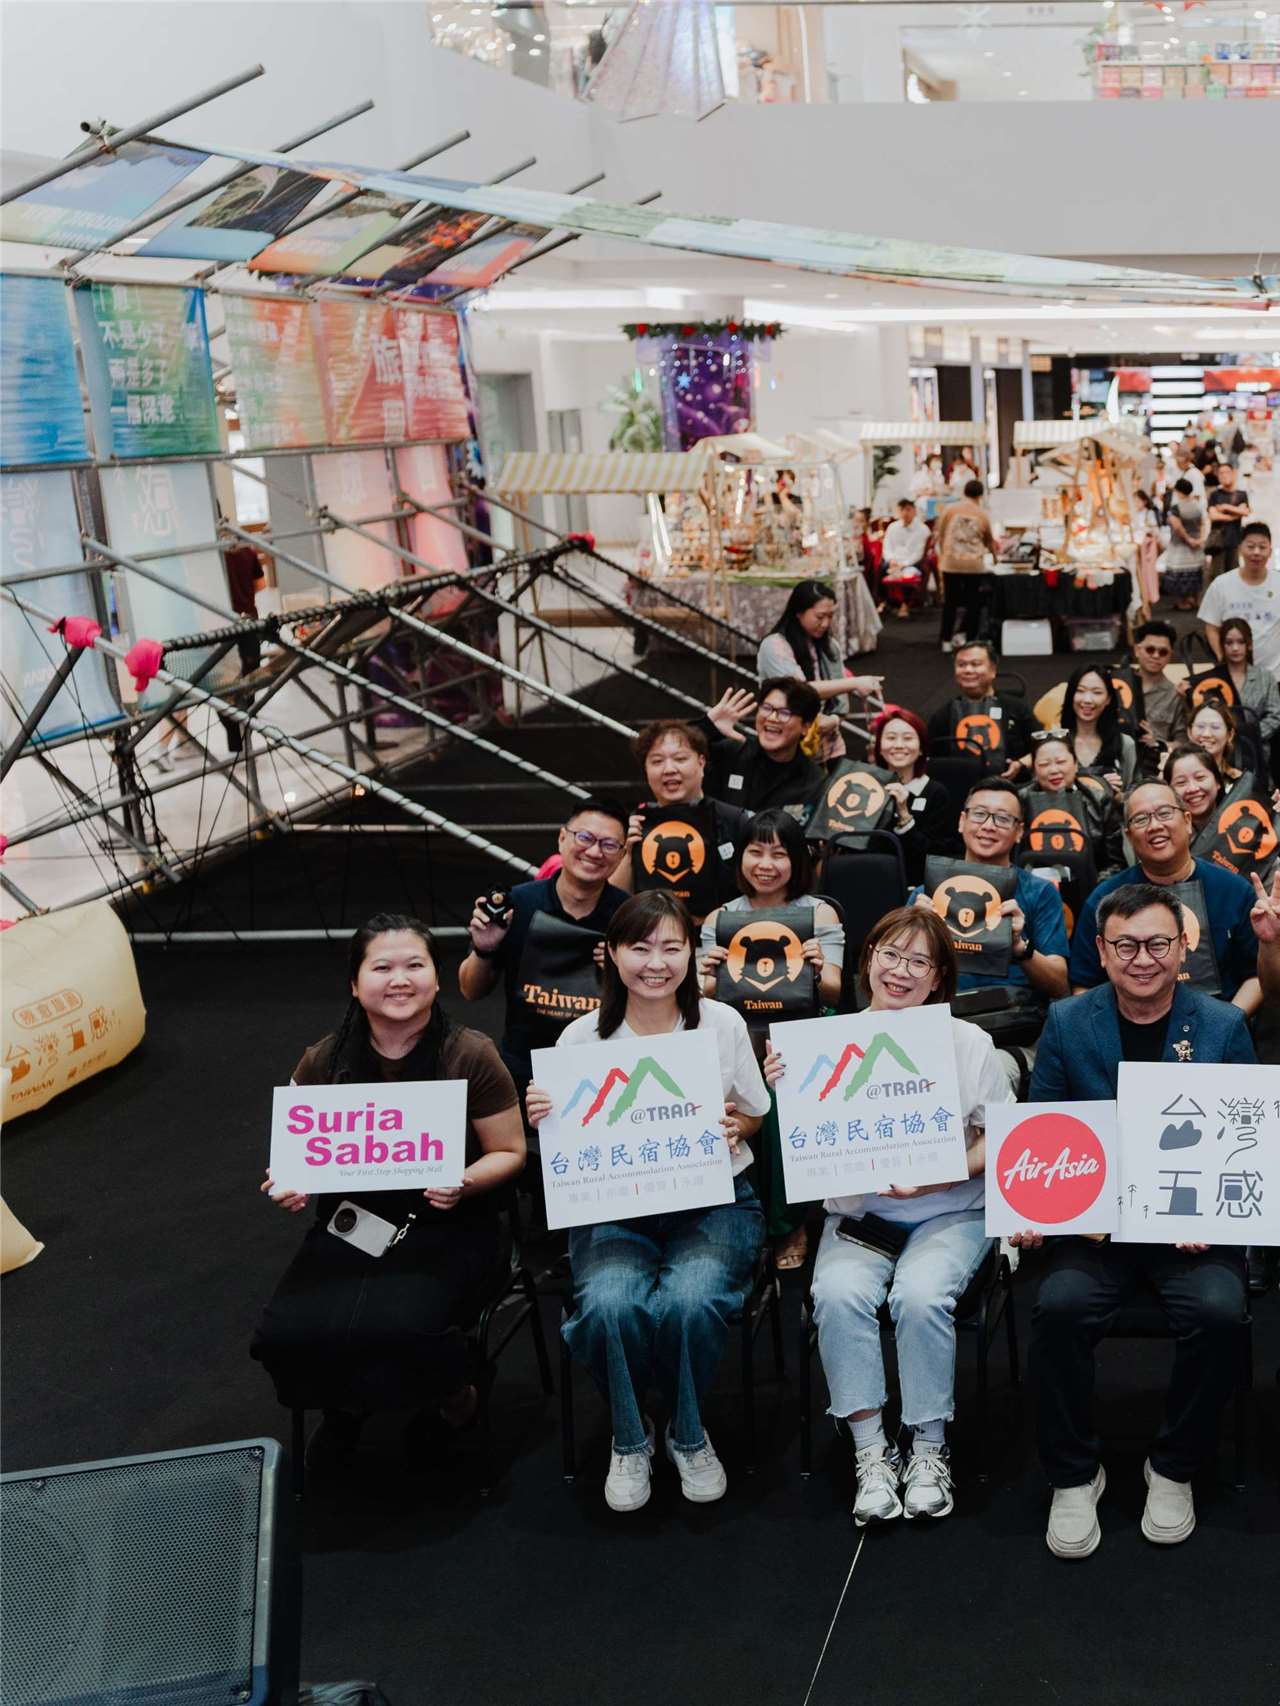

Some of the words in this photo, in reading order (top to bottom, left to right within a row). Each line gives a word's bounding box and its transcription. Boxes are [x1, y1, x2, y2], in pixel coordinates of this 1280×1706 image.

[523, 984, 602, 1010] Taiwan
[743, 1000, 783, 1010] Taiwan
[287, 1102, 404, 1135] Suria
[788, 1106, 955, 1150] 台灣民宿協會
[304, 1132, 443, 1167] Sabah
[550, 1129, 721, 1176] 台灣民宿協會
[1004, 1147, 1100, 1190] AirAsia
